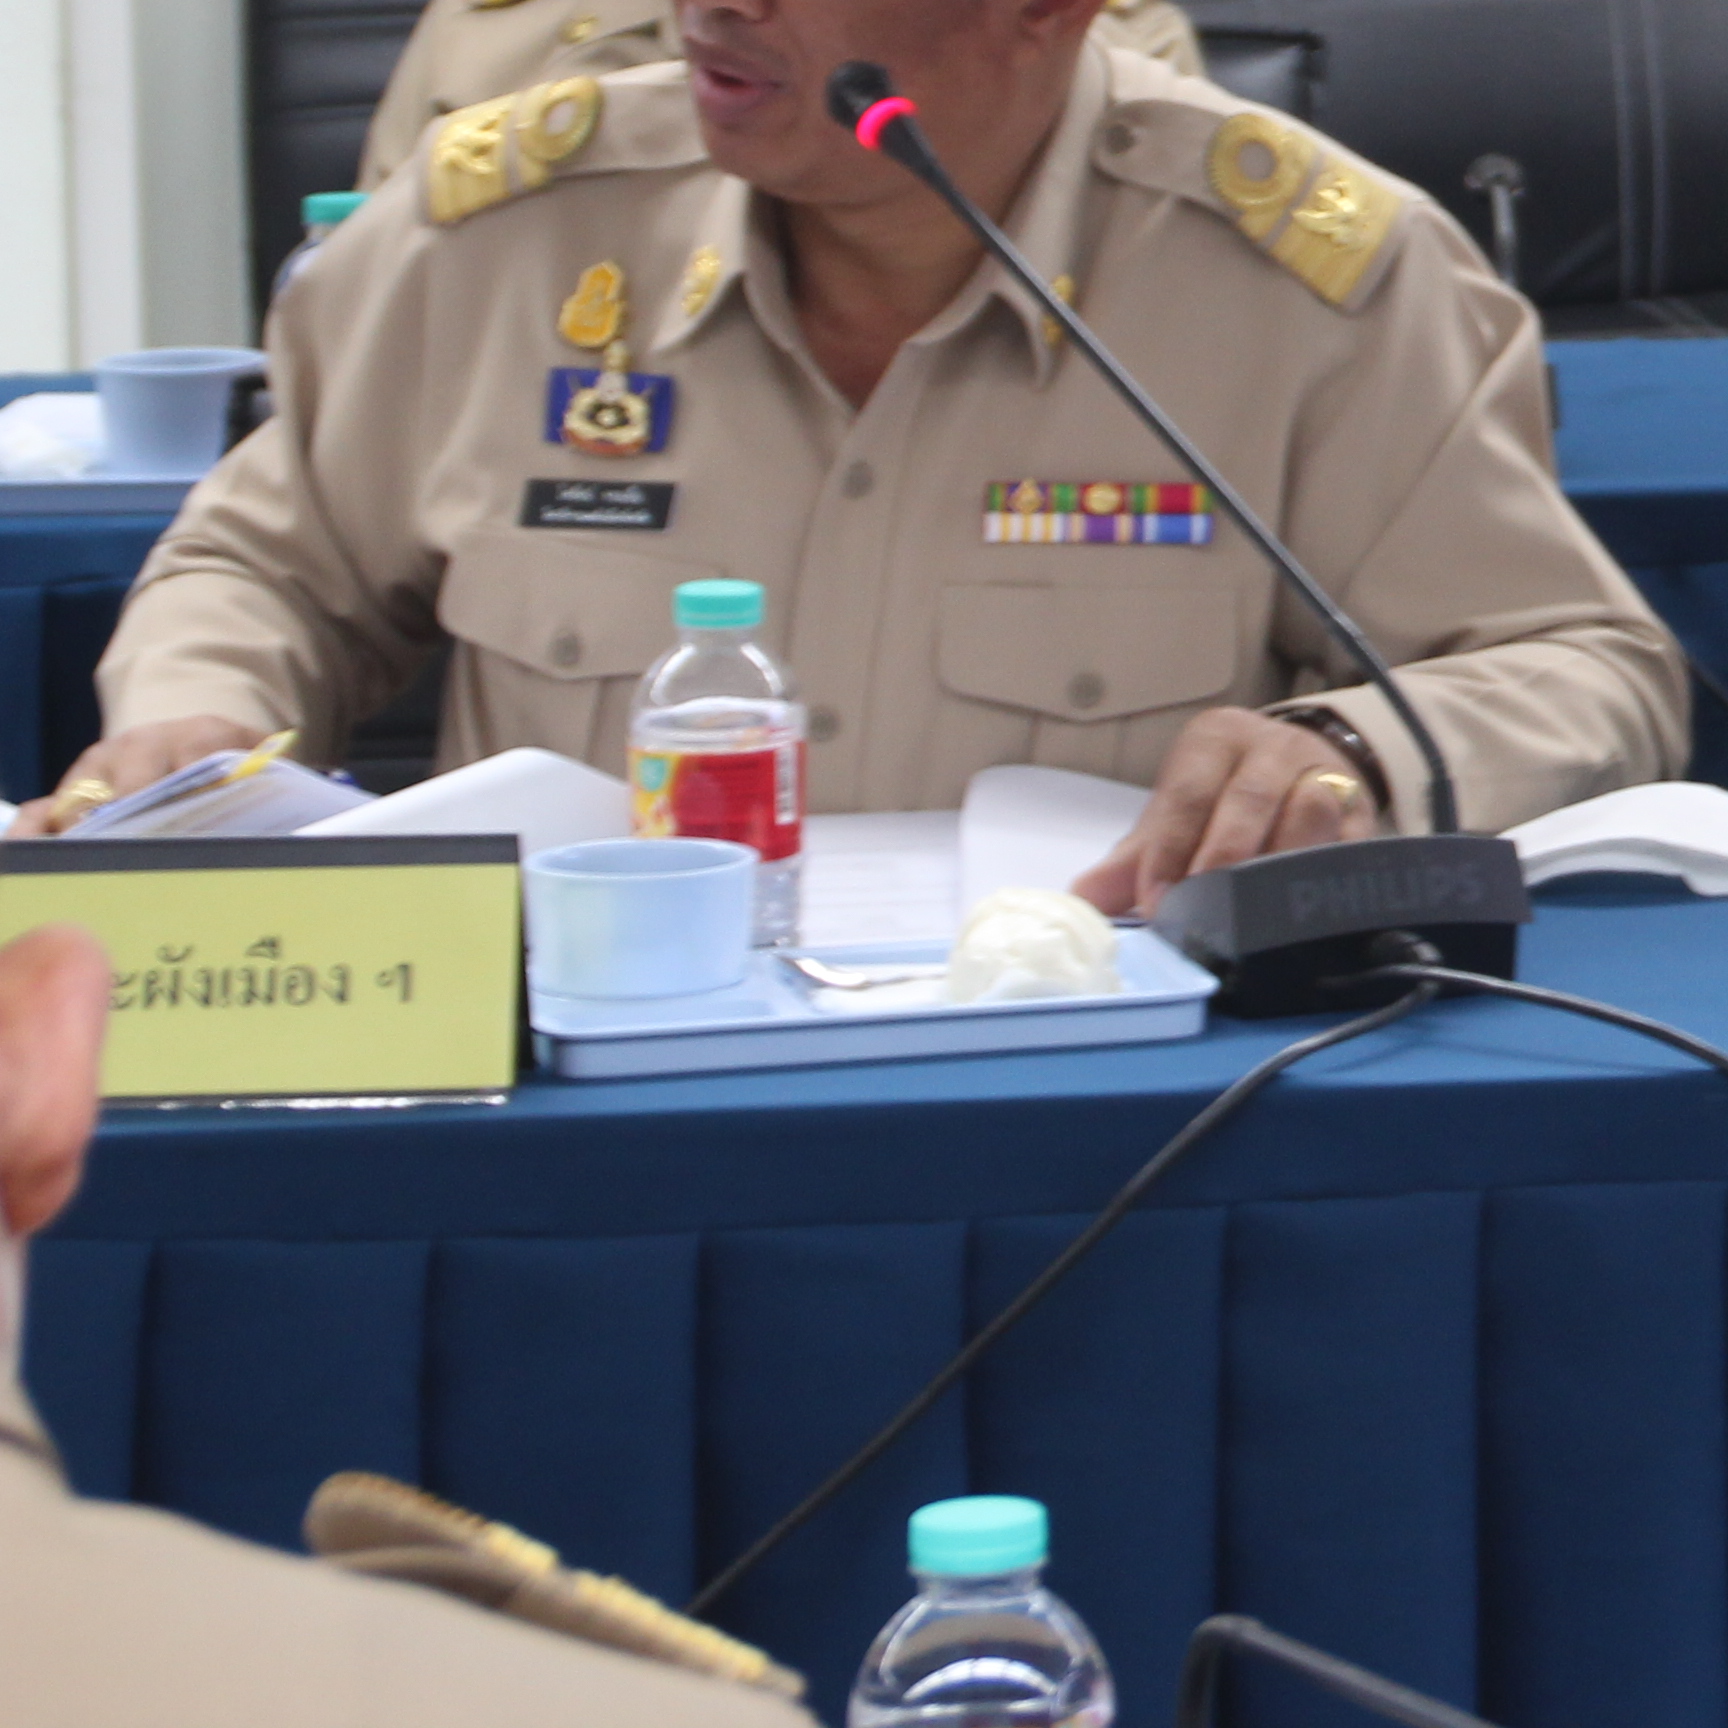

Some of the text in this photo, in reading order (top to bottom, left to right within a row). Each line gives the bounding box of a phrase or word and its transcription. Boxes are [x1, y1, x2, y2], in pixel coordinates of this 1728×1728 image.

[1286, 863, 1485, 922] PHILIPS
[106, 935, 353, 1012] ะผังเมือง
